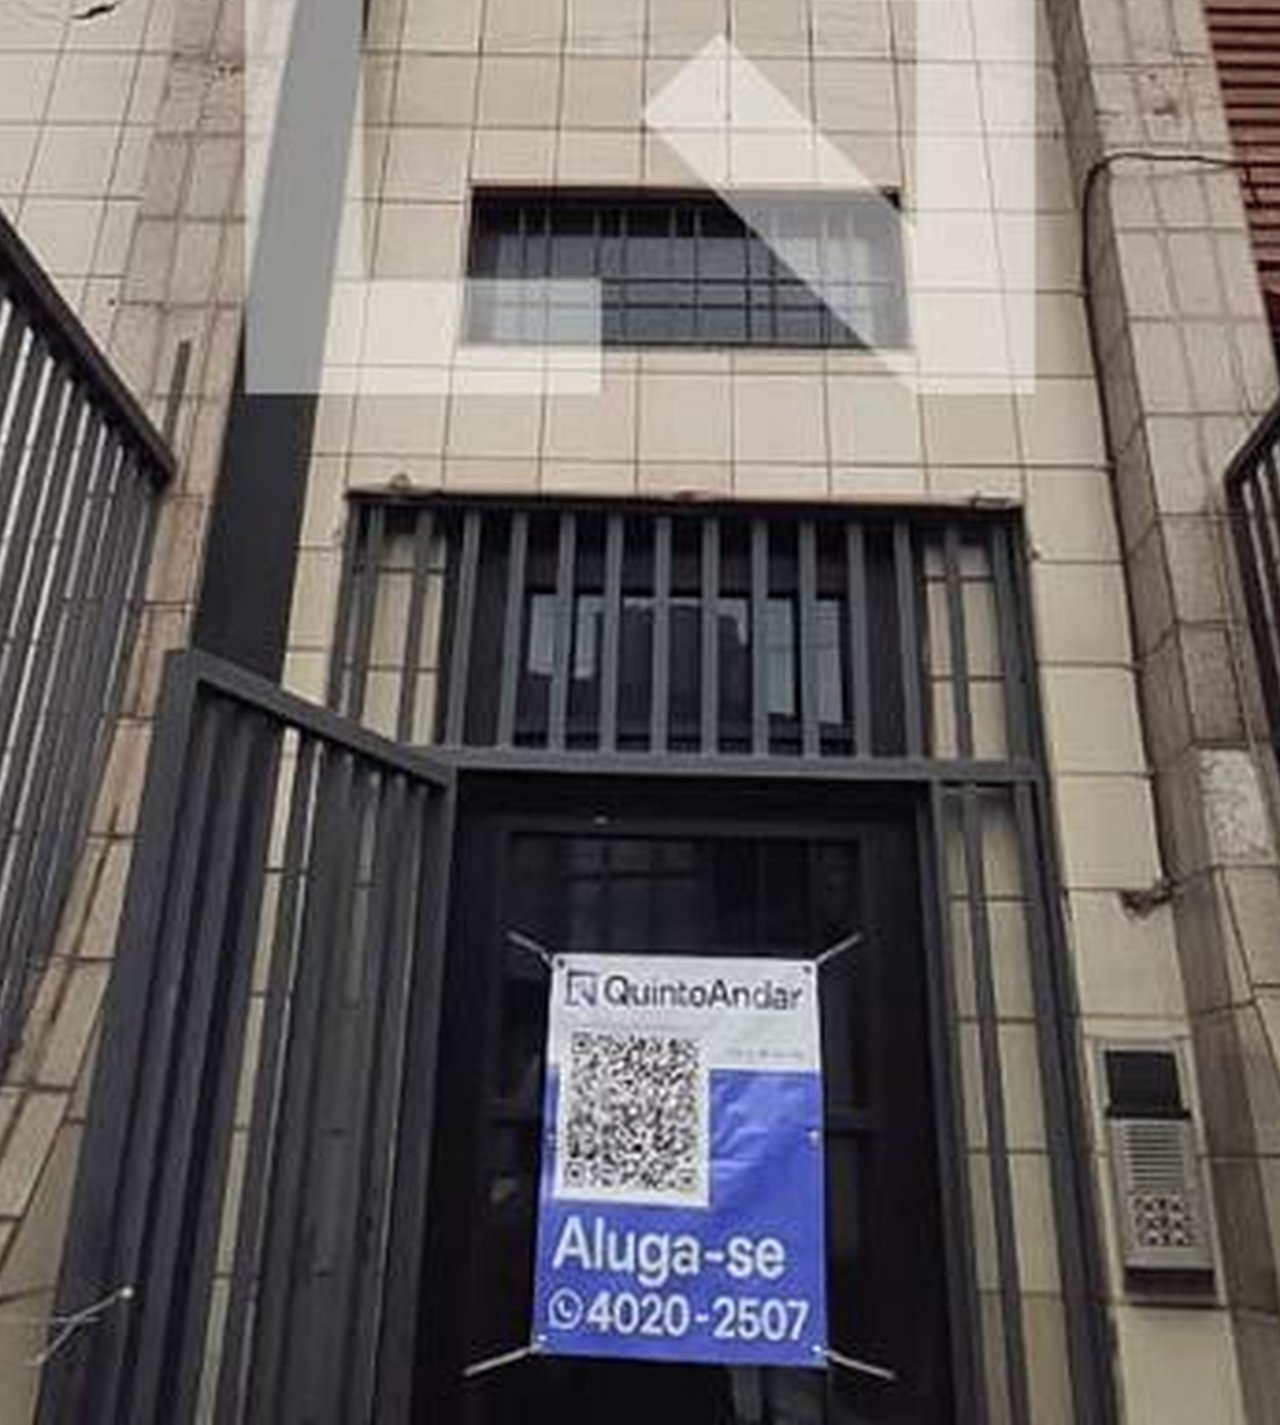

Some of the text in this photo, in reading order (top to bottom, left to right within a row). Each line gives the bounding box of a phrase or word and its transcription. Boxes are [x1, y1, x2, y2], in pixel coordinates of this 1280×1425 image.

[603, 975, 803, 1010] QuintoAndar
[552, 1216, 786, 1287] Aluga-se
[586, 1291, 809, 1341] 4020-2507
